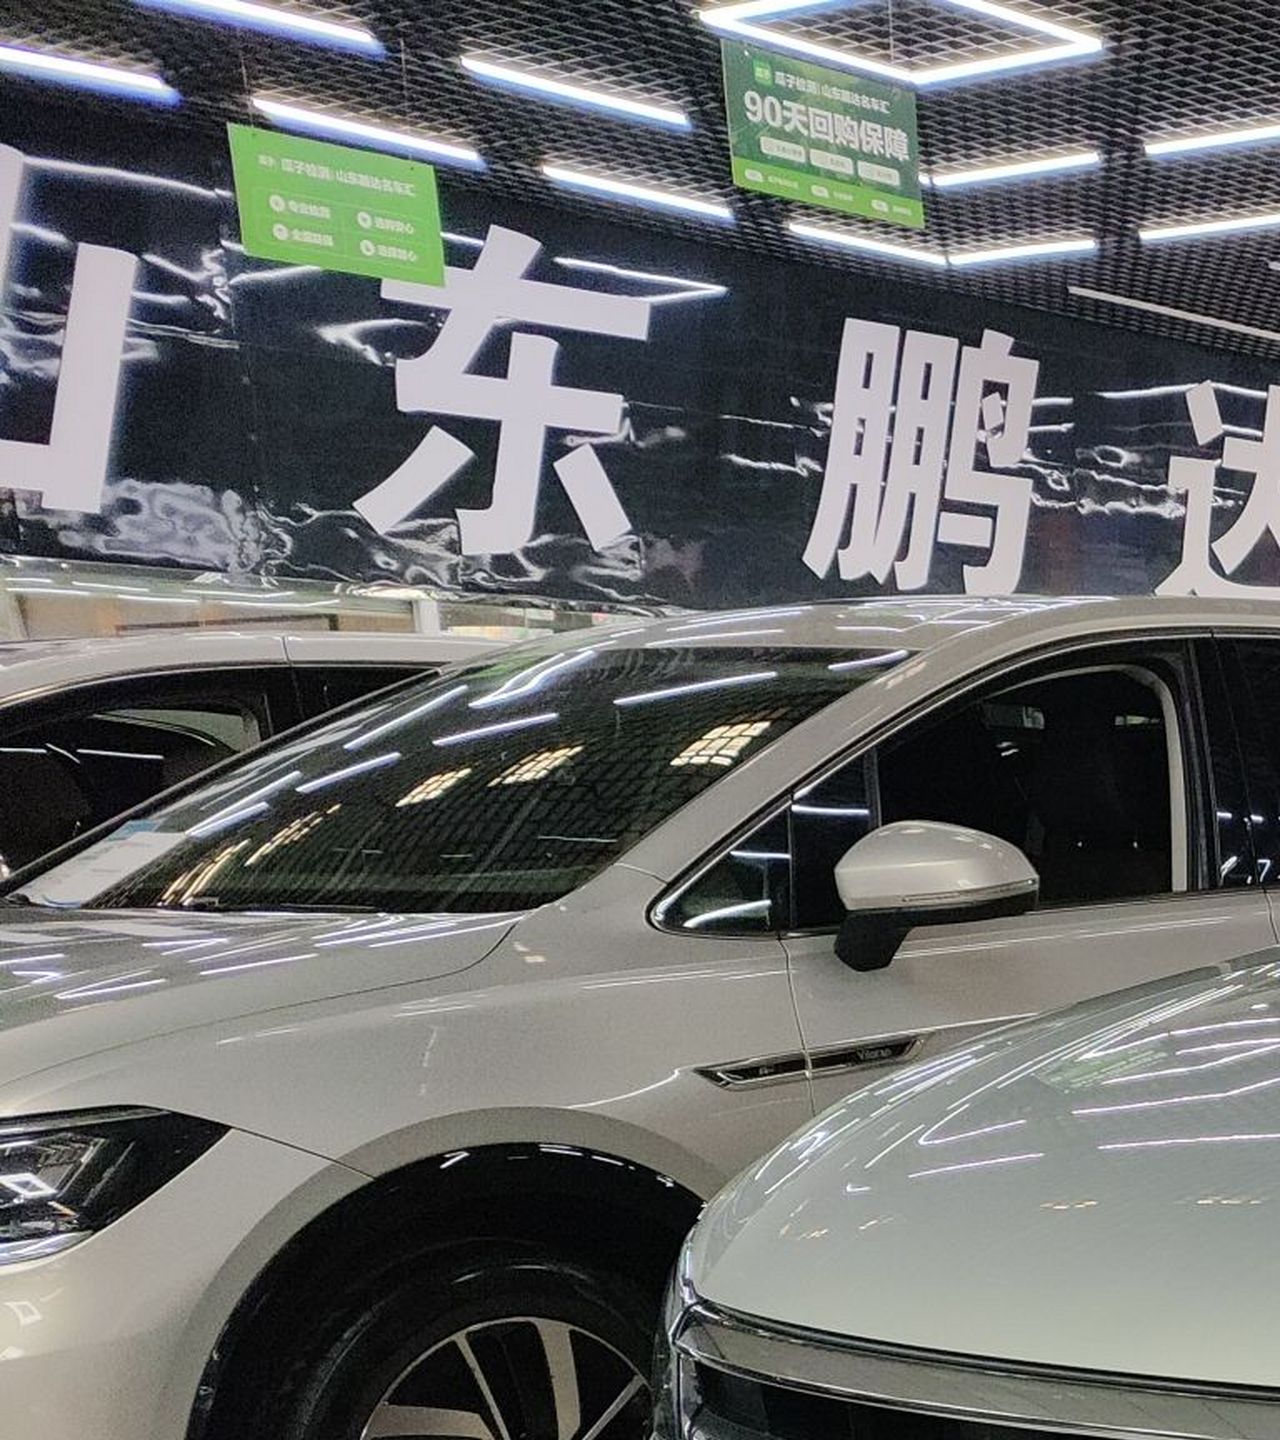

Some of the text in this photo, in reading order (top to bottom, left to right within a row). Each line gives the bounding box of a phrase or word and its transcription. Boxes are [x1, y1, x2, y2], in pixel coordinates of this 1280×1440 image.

[744, 90, 910, 162] 90天回购保障
